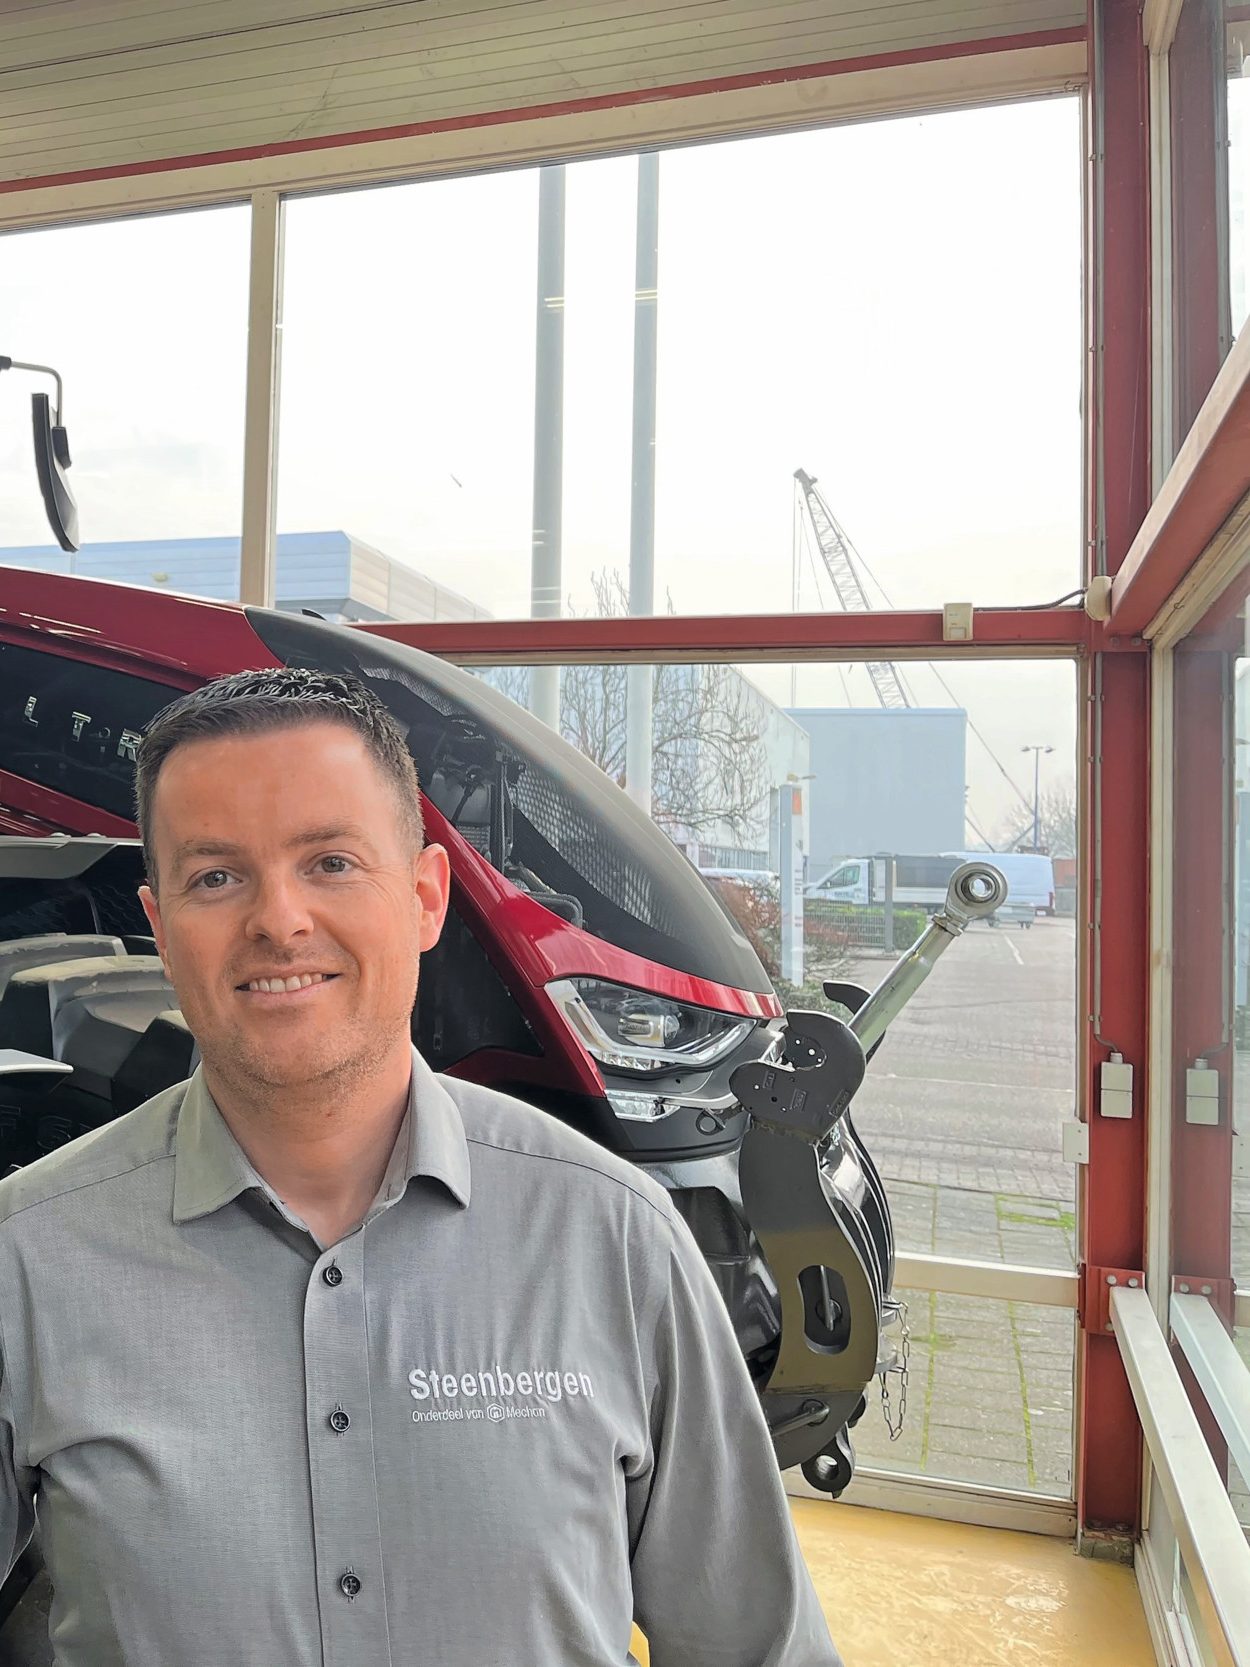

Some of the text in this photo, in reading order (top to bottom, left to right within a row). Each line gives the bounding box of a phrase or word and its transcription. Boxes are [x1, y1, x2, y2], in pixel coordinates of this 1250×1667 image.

[408, 1366, 595, 1402] Steenbergen
[412, 1406, 546, 1422] Onderdeel van Mechan
